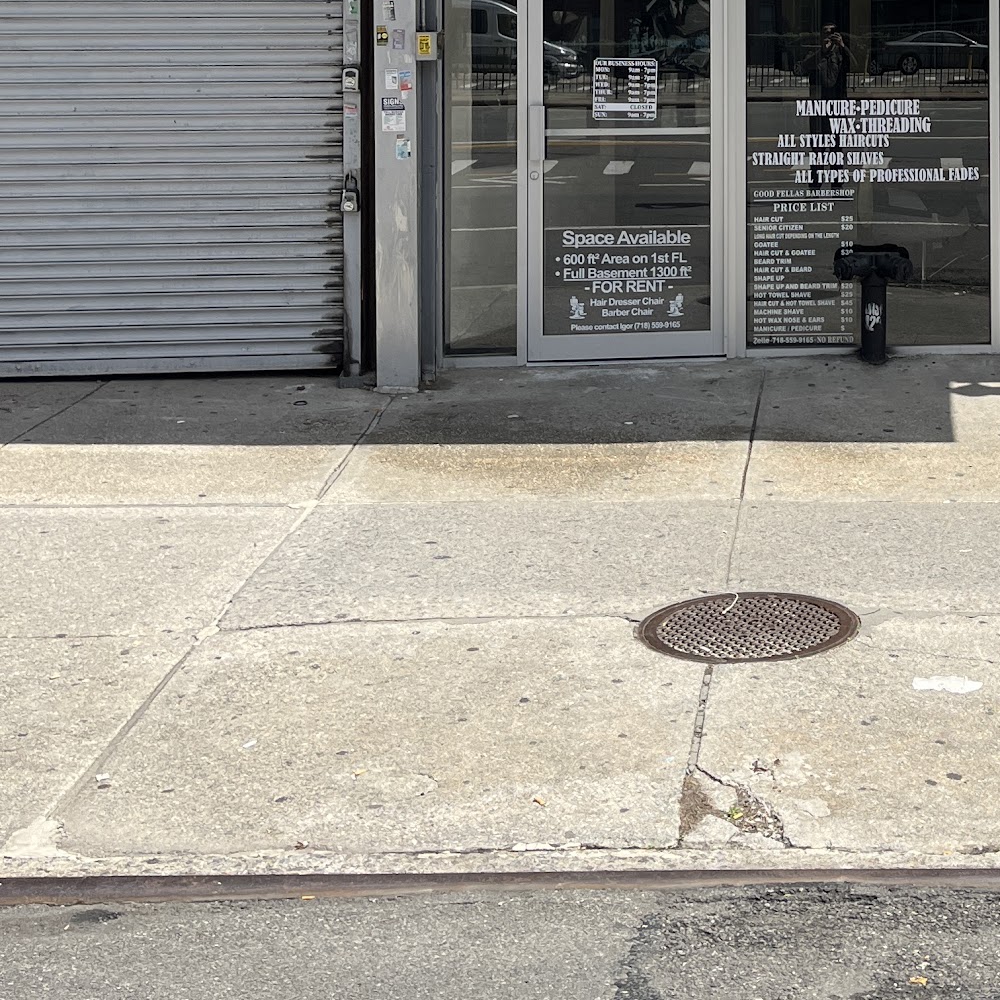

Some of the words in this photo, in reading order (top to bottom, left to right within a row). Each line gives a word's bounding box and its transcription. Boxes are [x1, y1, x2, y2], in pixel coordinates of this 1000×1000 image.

[777, 134, 796, 148] ALL
[799, 134, 836, 148] STYLES
[839, 134, 890, 148] HAIRCUTS
[752, 152, 805, 166] STRAIGHT
[809, 152, 844, 166] RAZOR
[847, 151, 884, 165] SHAVES
[794, 170, 813, 184] ALL
[816, 169, 850, 183] TYPES
[853, 169, 867, 183] OF
[869, 168, 946, 183] PROFESSIONAL
[949, 167, 979, 181] FADES
[753, 190, 775, 198] GOOD
[776, 189, 804, 197] FELLAS
[806, 189, 855, 197] BARBERSHOP
[773, 202, 807, 212] PRICE
[810, 202, 835, 212] LIST
[562, 230, 615, 249] Space
[617, 230, 691, 245] Available
[563, 253, 585, 265] 600
[601, 253, 630, 265] Area
[632, 255, 648, 264] on
[651, 252, 669, 264] 1st
[672, 252, 687, 263] FL
[563, 267, 585, 279] Full
[588, 267, 647, 279] Basement
[651, 266, 678, 278] 1300
[592, 280, 623, 293] FOR
[626, 279, 665, 293] RENT
[590, 298, 607, 307] Hair
[608, 298, 641, 306] Dresser
[642, 297, 665, 305] Chair
[601, 308, 631, 317] Barber
[631, 308, 654, 316] Chair
[594, 323, 619, 331] contact
[619, 322, 634, 332] Igor
[651, 321, 681, 329] 559-9165
[828, 336, 854, 344] REFUND
